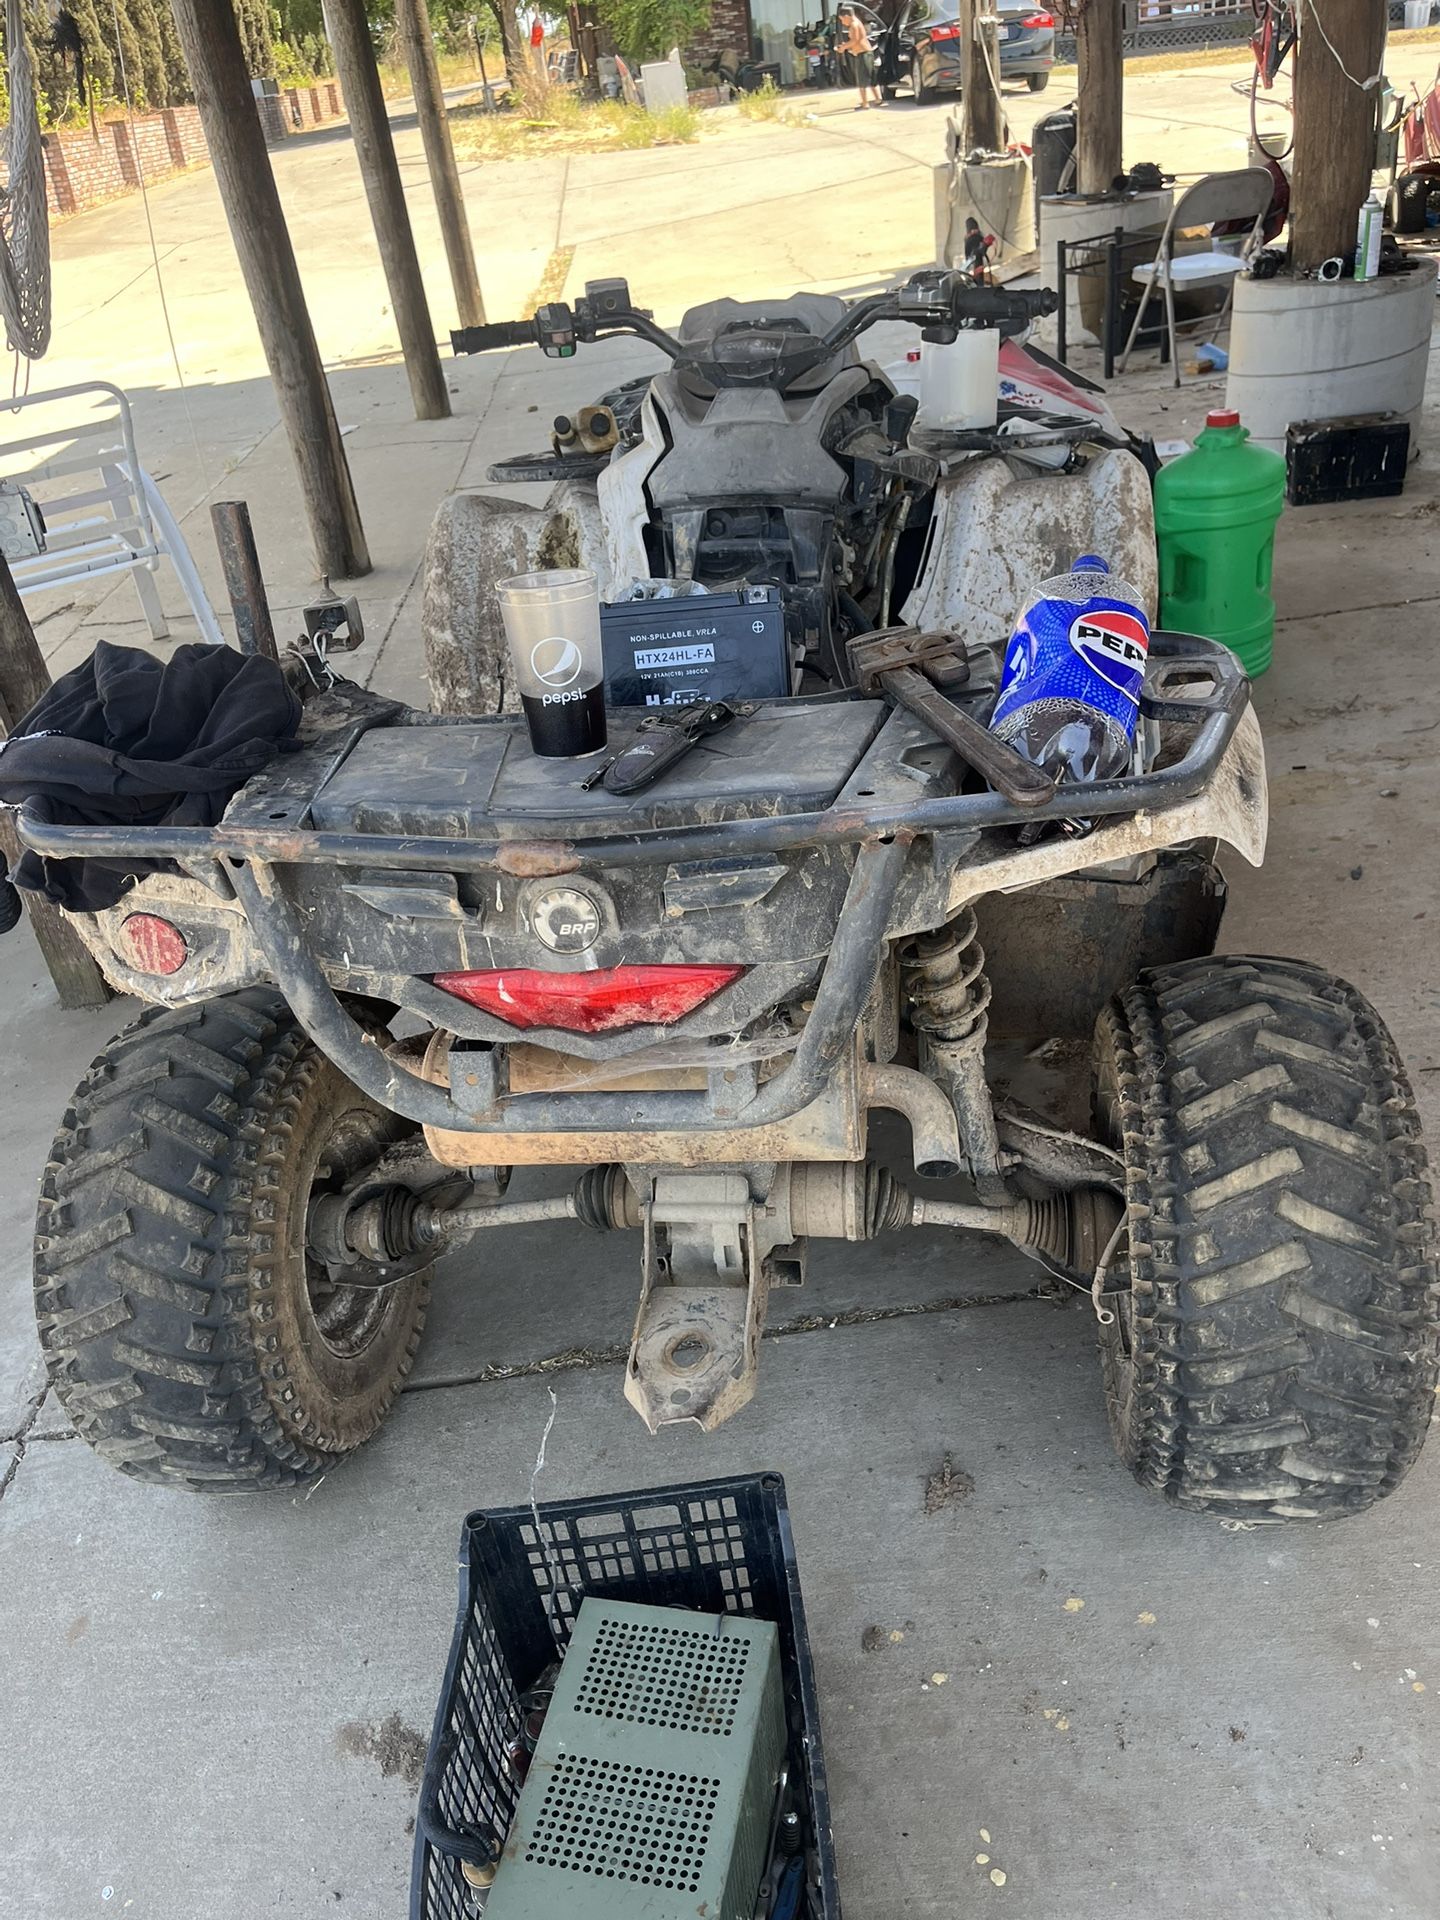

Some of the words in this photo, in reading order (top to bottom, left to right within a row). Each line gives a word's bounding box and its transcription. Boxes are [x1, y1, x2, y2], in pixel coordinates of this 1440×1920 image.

[636, 648, 713, 664] HTX24HL-FA
[542, 687, 583, 707] pepsi
[559, 922, 596, 935] BRP
